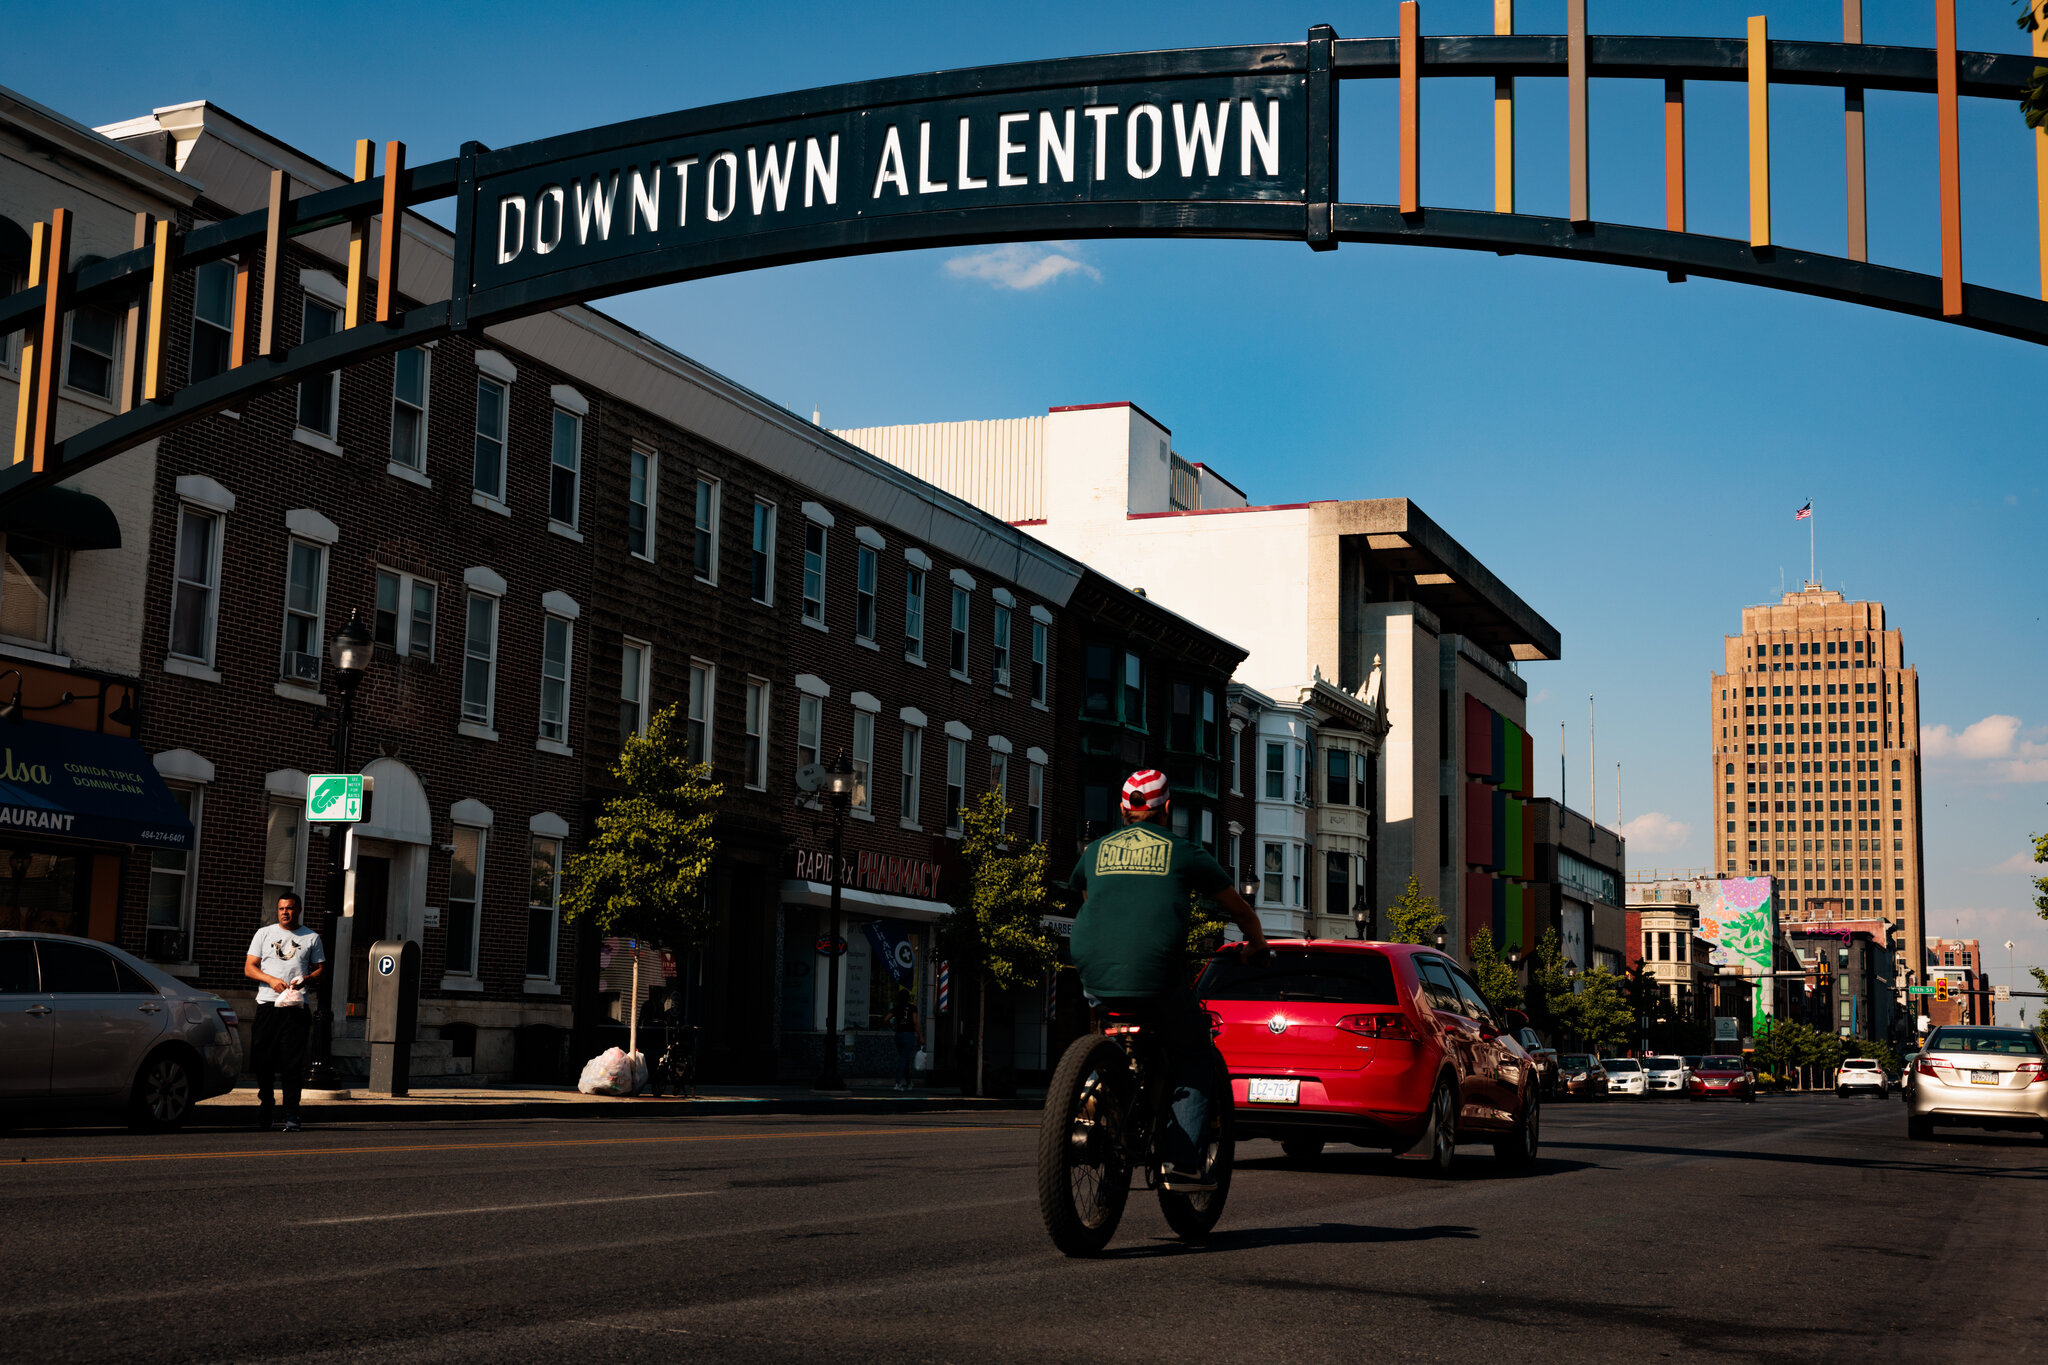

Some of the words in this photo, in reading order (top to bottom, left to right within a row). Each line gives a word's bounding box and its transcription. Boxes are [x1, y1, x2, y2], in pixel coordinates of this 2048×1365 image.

[498, 132, 840, 265] DOWNTOWN
[873, 99, 1280, 199] ALLENTOWN
[63, 762, 109, 778] COMIDA
[107, 769, 144, 783] TIPICA
[72, 776, 144, 795] DOMINICANA
[1099, 844, 1166, 867] COLUMBIA
[796, 849, 833, 882] RAPID
[856, 850, 942, 899] PHARMACY
[382, 958, 392, 973] P
